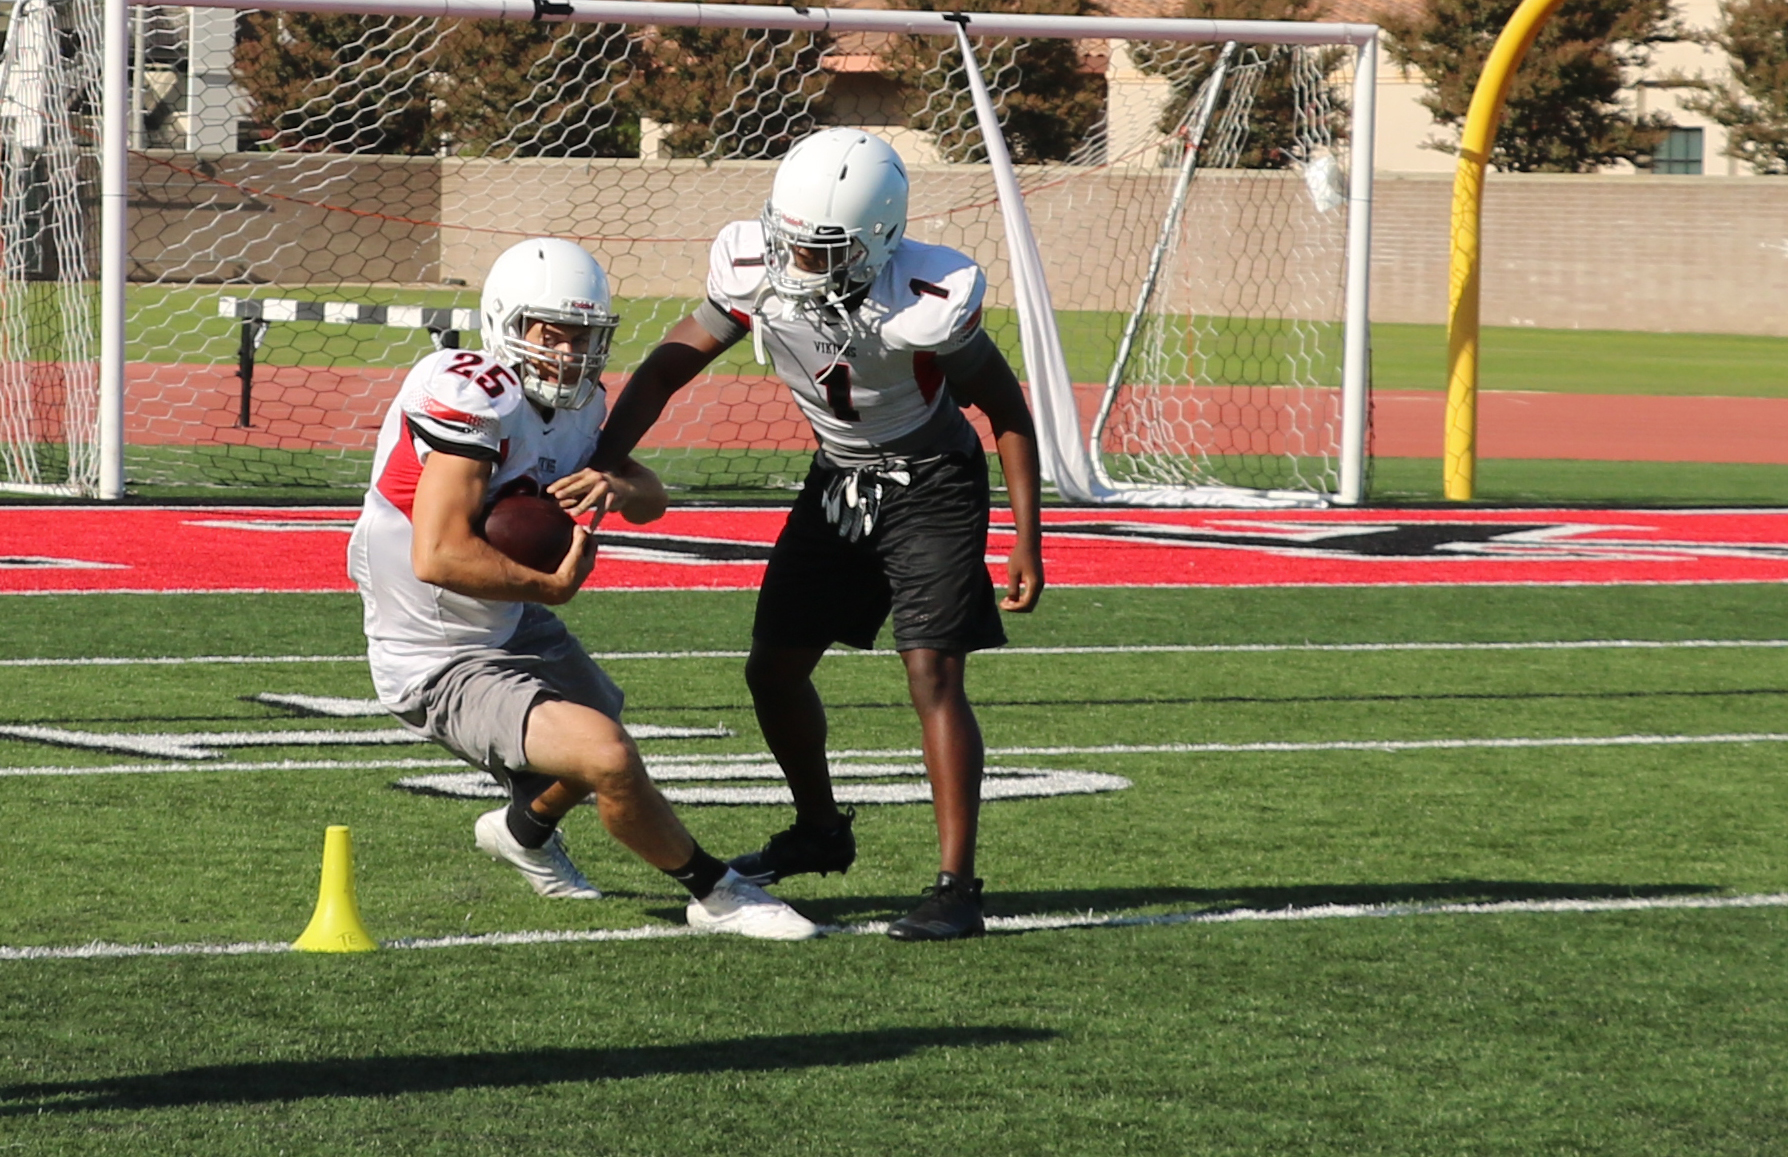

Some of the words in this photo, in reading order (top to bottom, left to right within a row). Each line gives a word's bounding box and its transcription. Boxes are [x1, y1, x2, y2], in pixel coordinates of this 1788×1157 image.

[908, 277, 950, 300] 1
[445, 352, 518, 399] 25
[814, 361, 861, 422] 1
